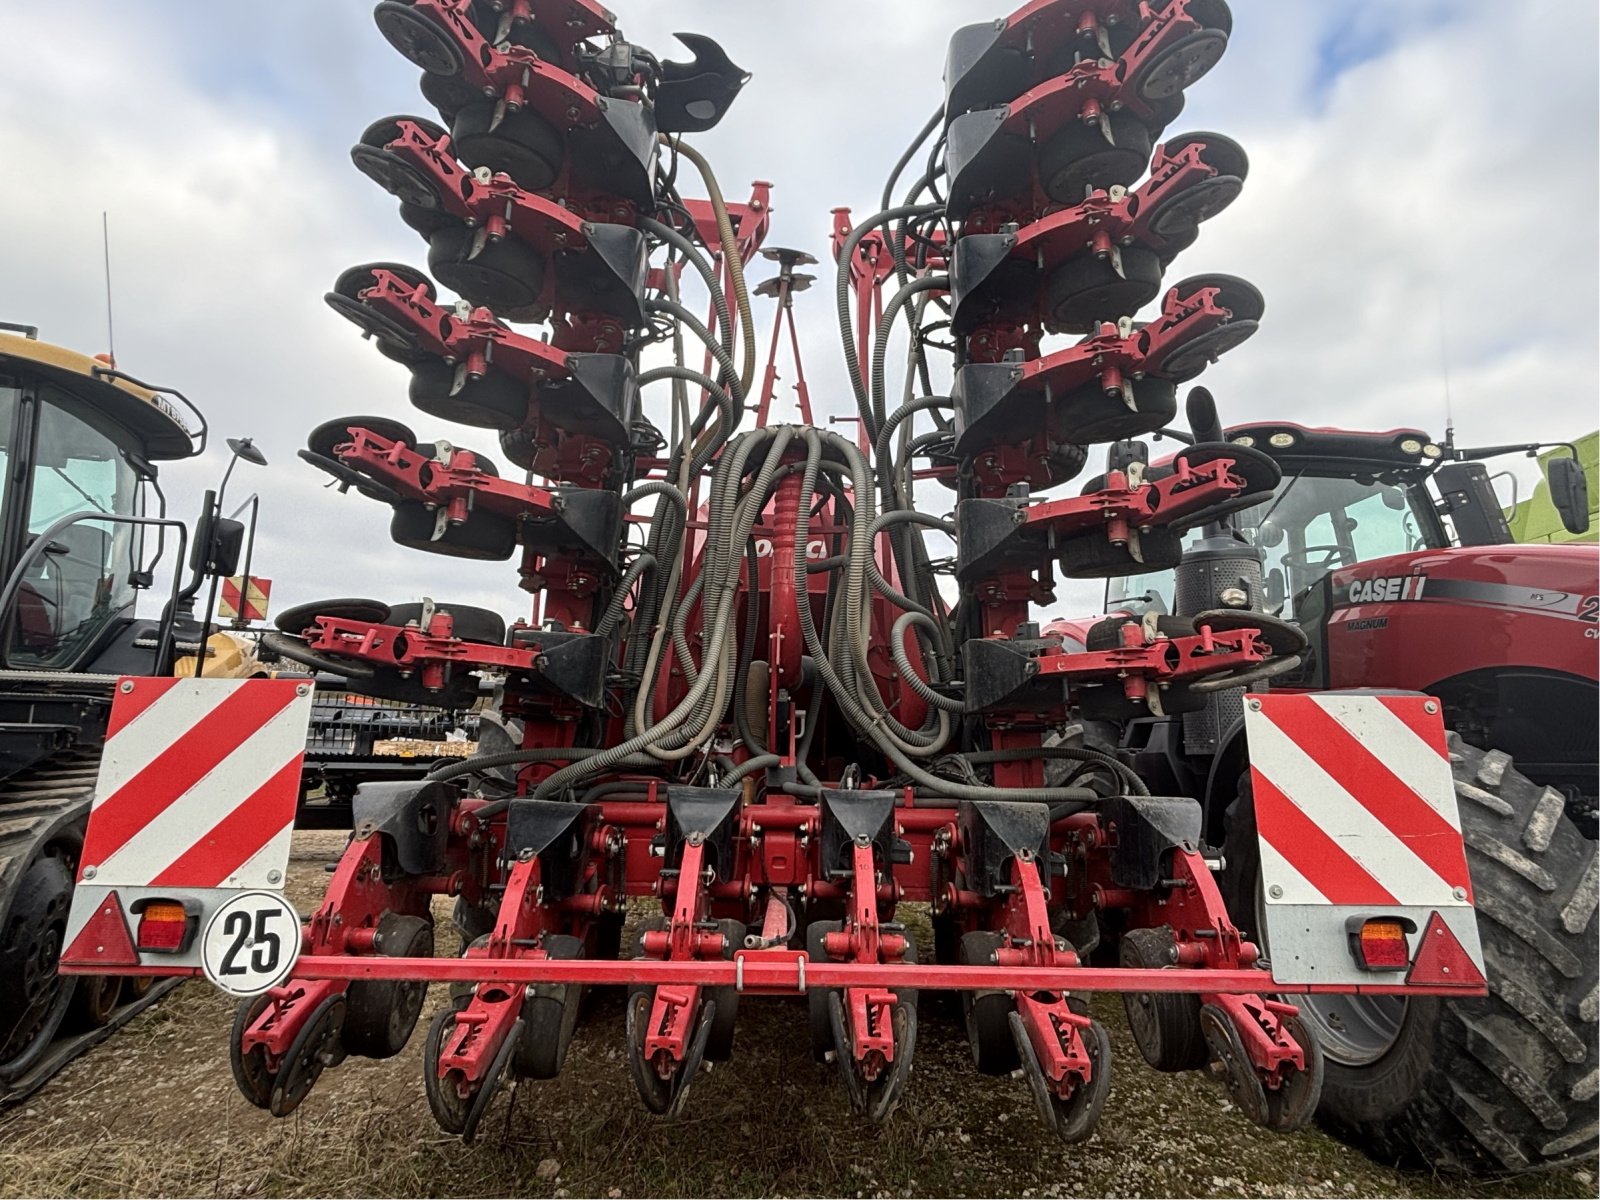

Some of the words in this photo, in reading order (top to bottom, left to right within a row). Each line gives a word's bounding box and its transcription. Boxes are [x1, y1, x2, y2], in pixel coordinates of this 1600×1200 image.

[1349, 578, 1402, 603] CASE
[1346, 617, 1389, 631] MAGNUM
[219, 908, 282, 977] 25
